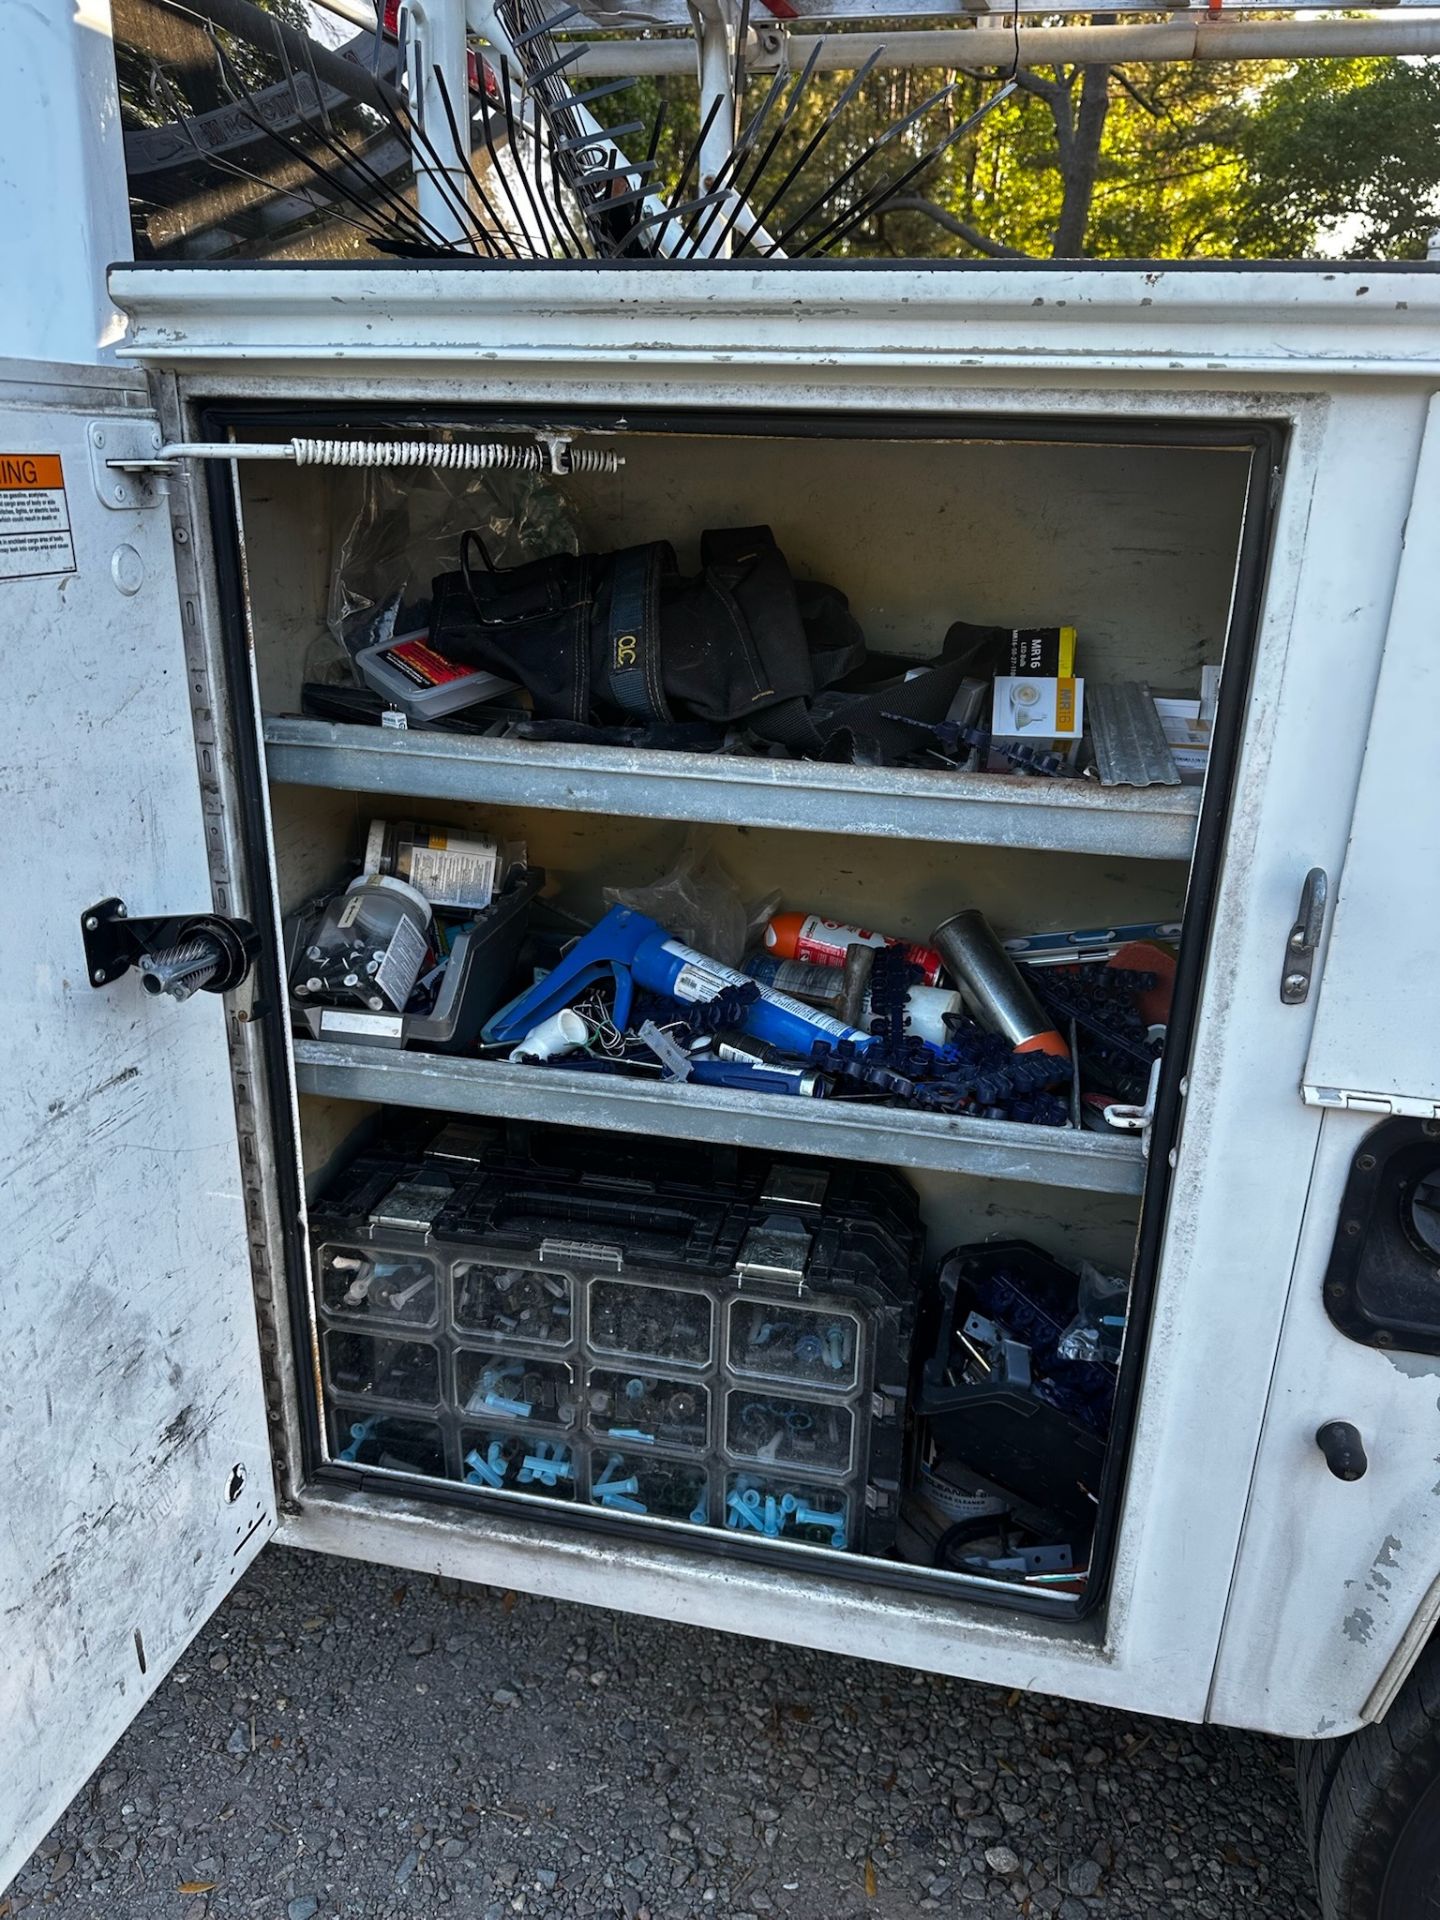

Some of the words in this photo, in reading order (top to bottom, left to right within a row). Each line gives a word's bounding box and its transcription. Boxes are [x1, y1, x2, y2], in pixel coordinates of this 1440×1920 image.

[0, 460, 38, 484] ING
[1030, 639, 1042, 669] MR16
[1059, 688, 1072, 723] MR16
